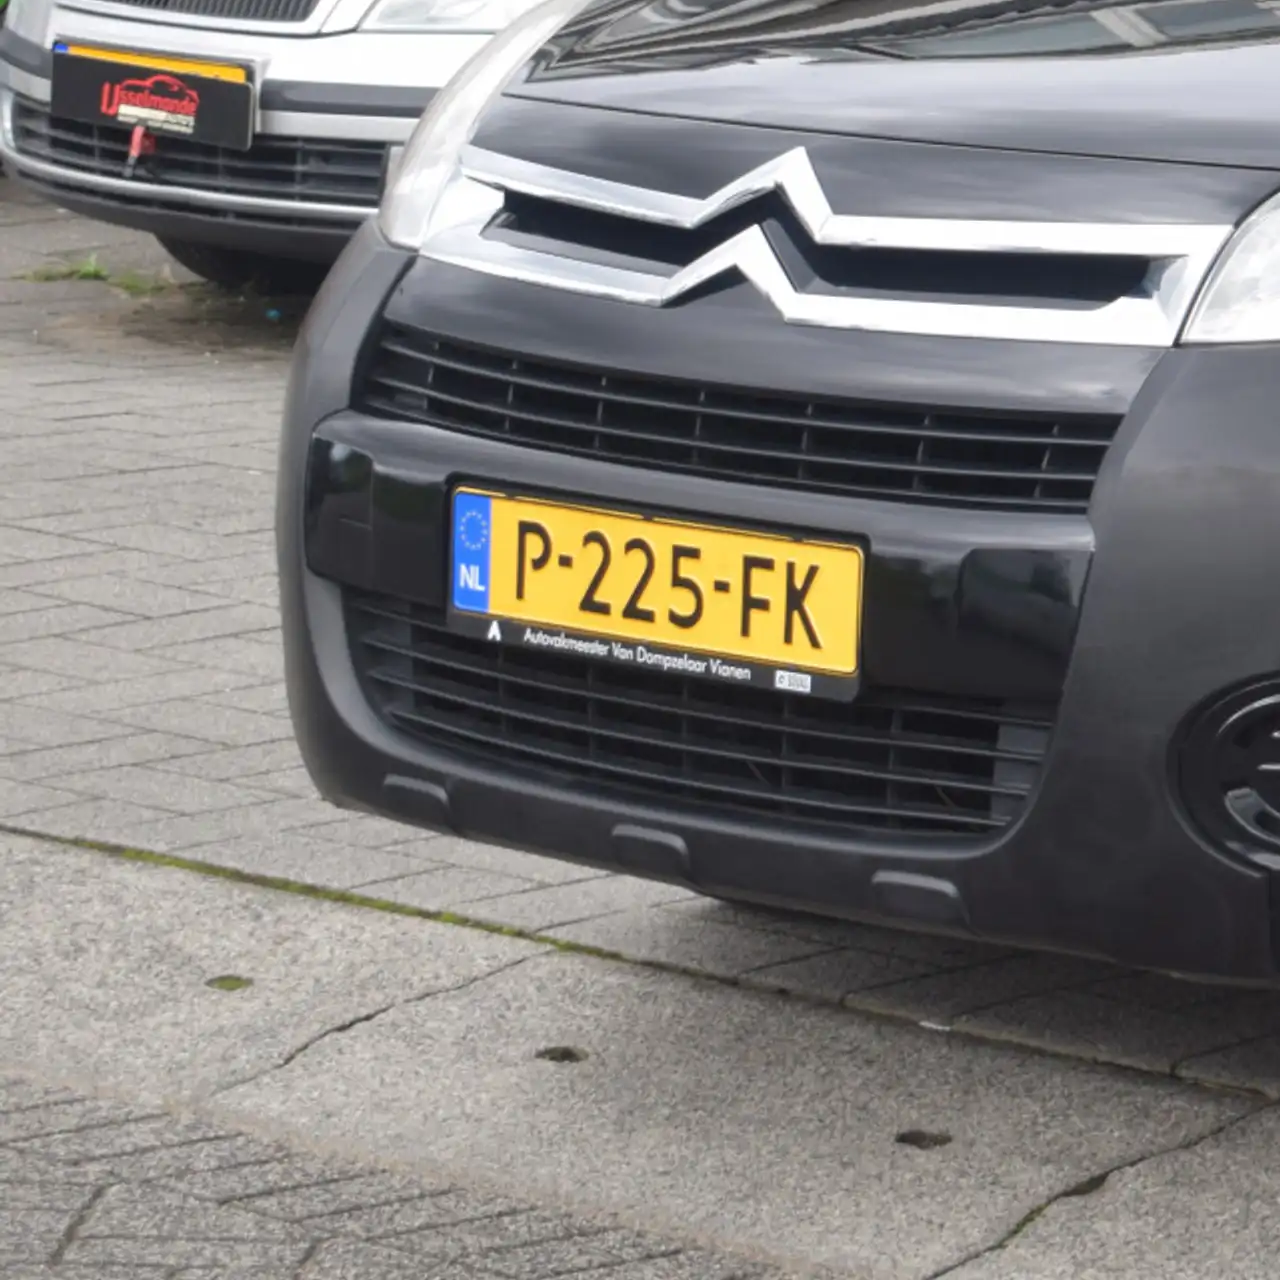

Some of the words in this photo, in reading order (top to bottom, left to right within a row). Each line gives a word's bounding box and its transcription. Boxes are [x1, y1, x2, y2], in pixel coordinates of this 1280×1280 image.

[459, 563, 486, 592] NL
[516, 520, 823, 650] P-225-FK
[611, 641, 634, 660] Van
